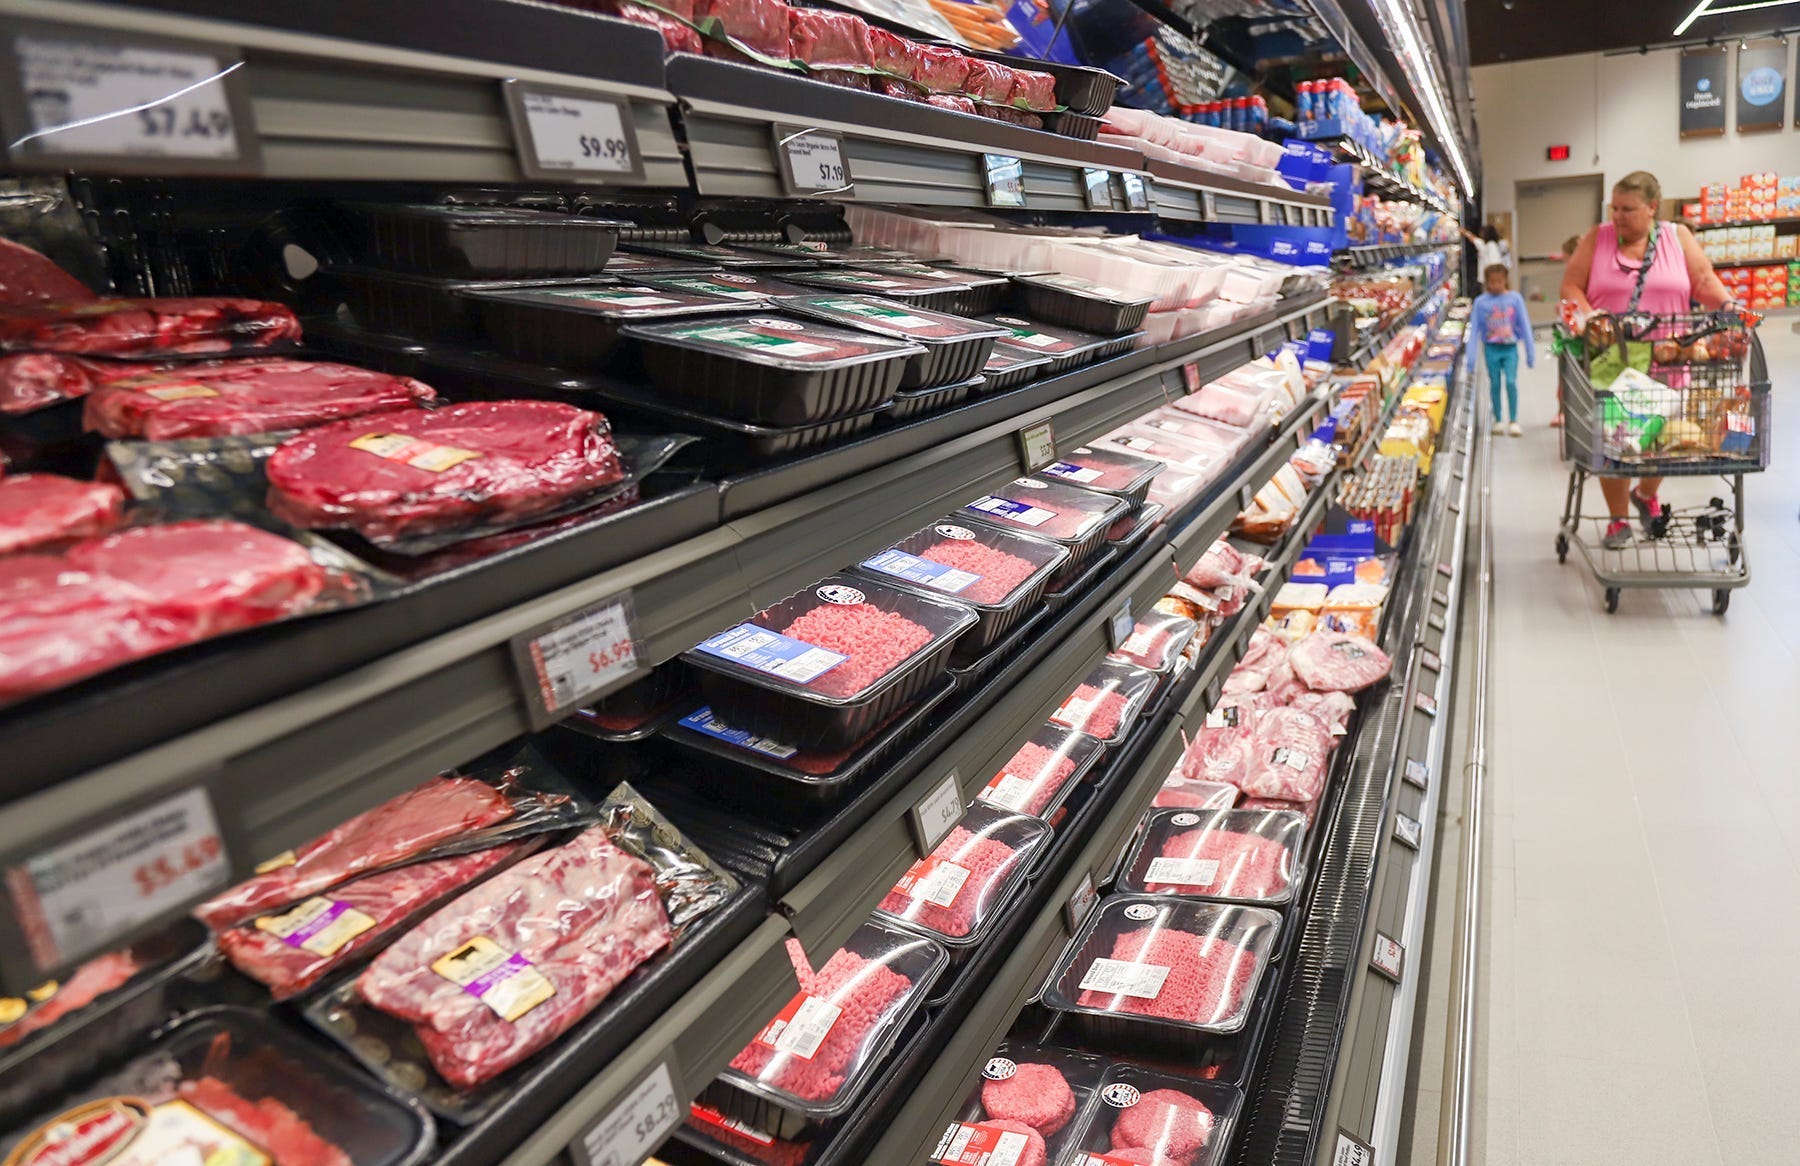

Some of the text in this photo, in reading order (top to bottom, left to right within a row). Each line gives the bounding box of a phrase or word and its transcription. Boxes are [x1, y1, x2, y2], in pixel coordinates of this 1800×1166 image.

[579, 134, 626, 158] $9.99
[819, 163, 844, 181] $7.19
[588, 639, 633, 674] $6.99
[636, 1094, 674, 1143] $8.29
